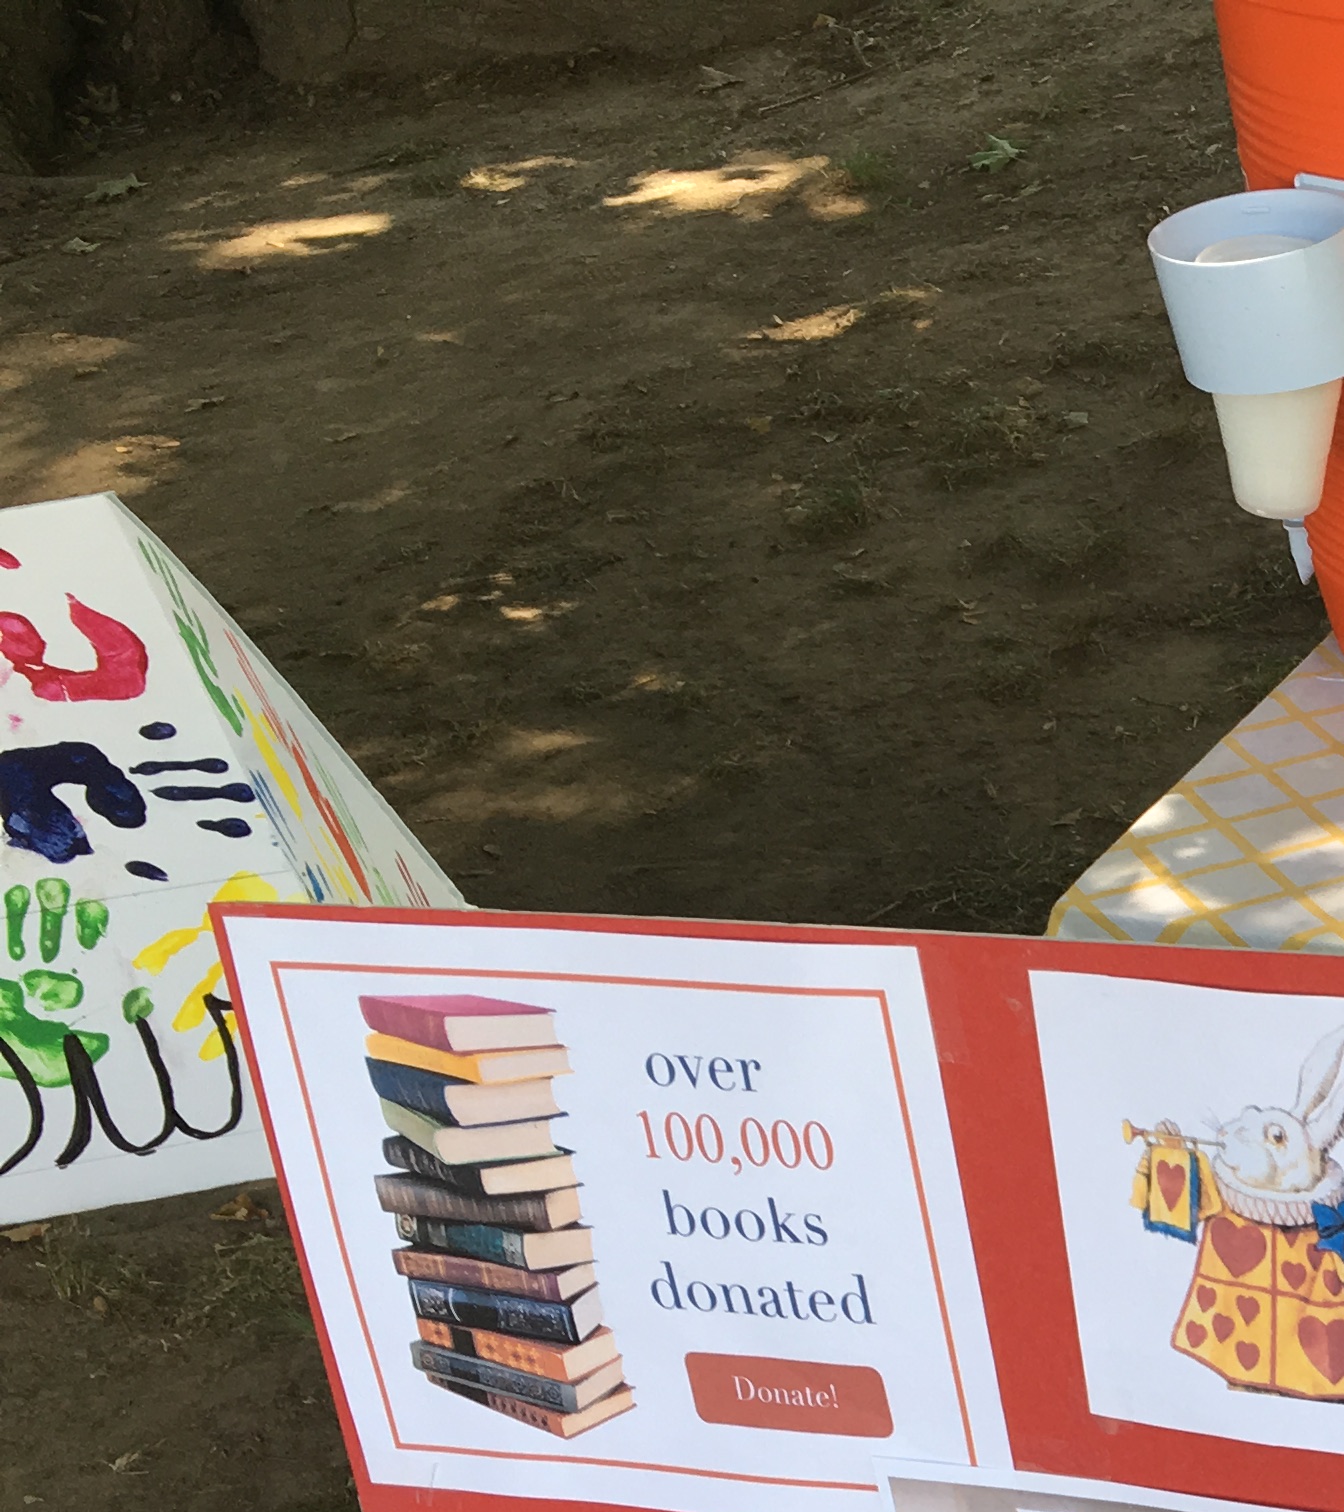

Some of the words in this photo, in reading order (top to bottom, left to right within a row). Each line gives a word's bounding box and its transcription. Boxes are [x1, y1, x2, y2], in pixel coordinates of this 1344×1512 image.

[645, 1050, 761, 1093] over
[636, 1110, 835, 1175] 100,000
[662, 1189, 829, 1247] books
[650, 1261, 877, 1326] donated
[733, 1375, 840, 1410] Donate!
